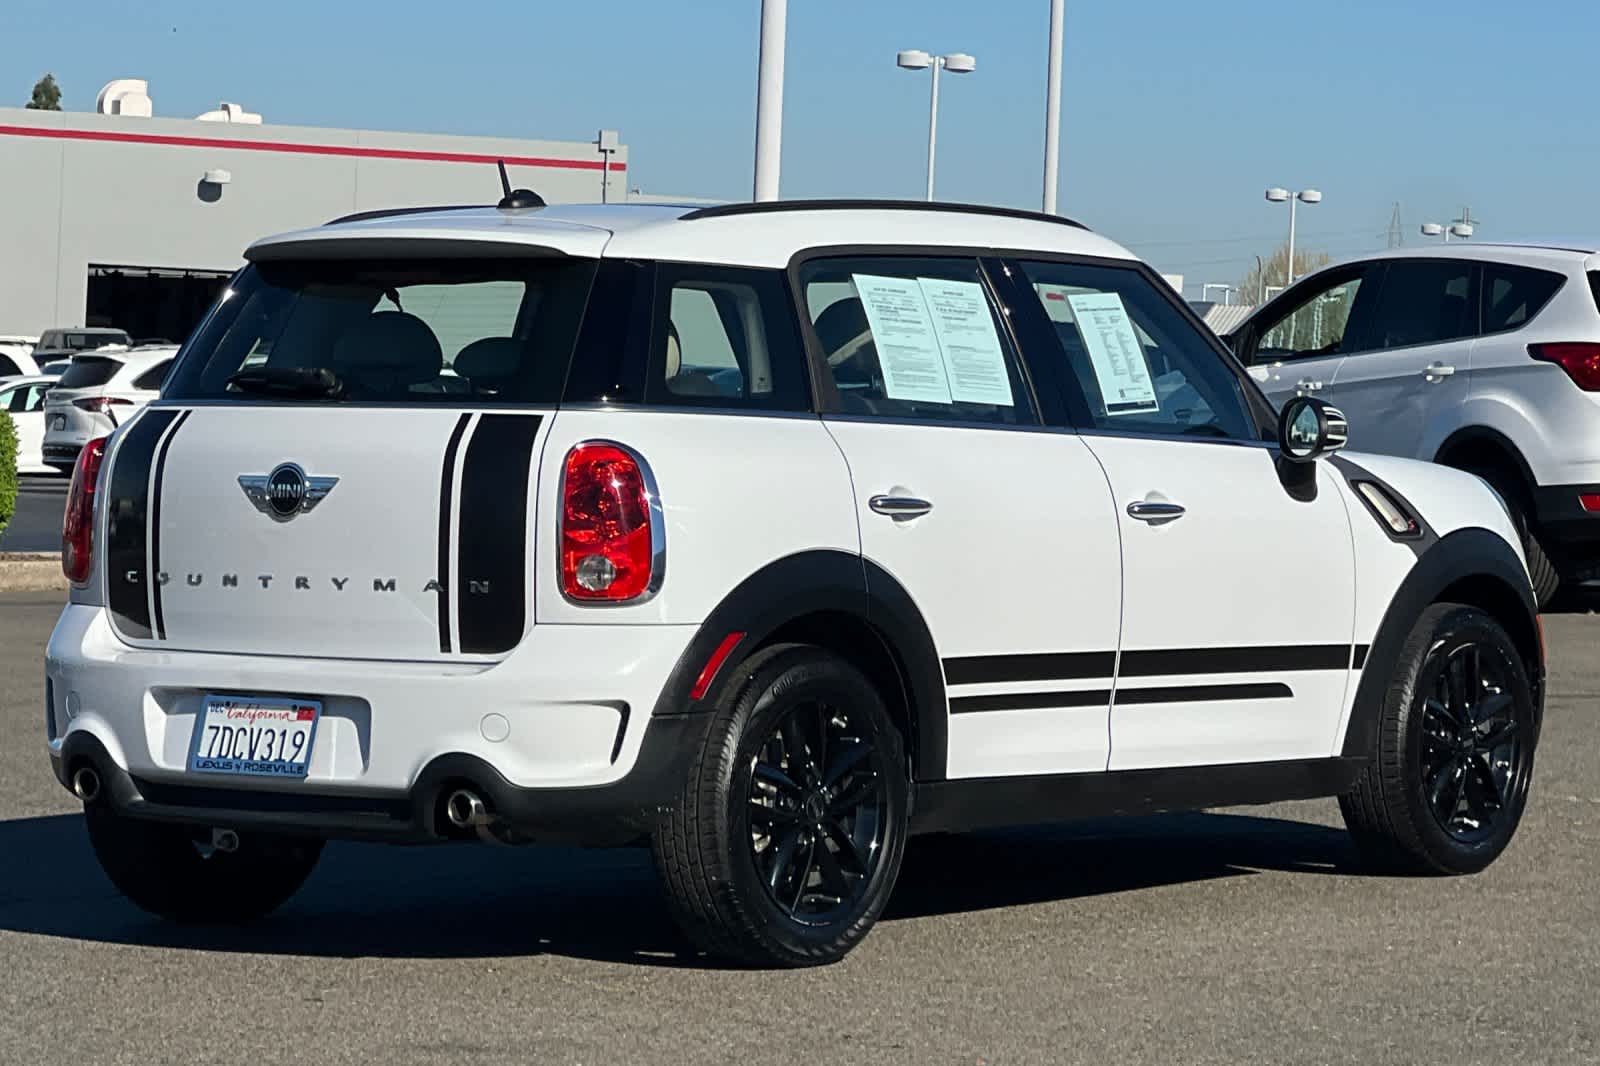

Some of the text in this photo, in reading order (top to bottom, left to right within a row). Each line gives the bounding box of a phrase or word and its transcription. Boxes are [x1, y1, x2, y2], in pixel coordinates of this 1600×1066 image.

[271, 483, 301, 498] MINI
[126, 571, 489, 593] COUNTRYMAN
[227, 703, 294, 725] California
[208, 725, 306, 762] 7DCV319
[196, 759, 232, 770] LEXUS
[244, 761, 305, 774] ROSEVILLE
